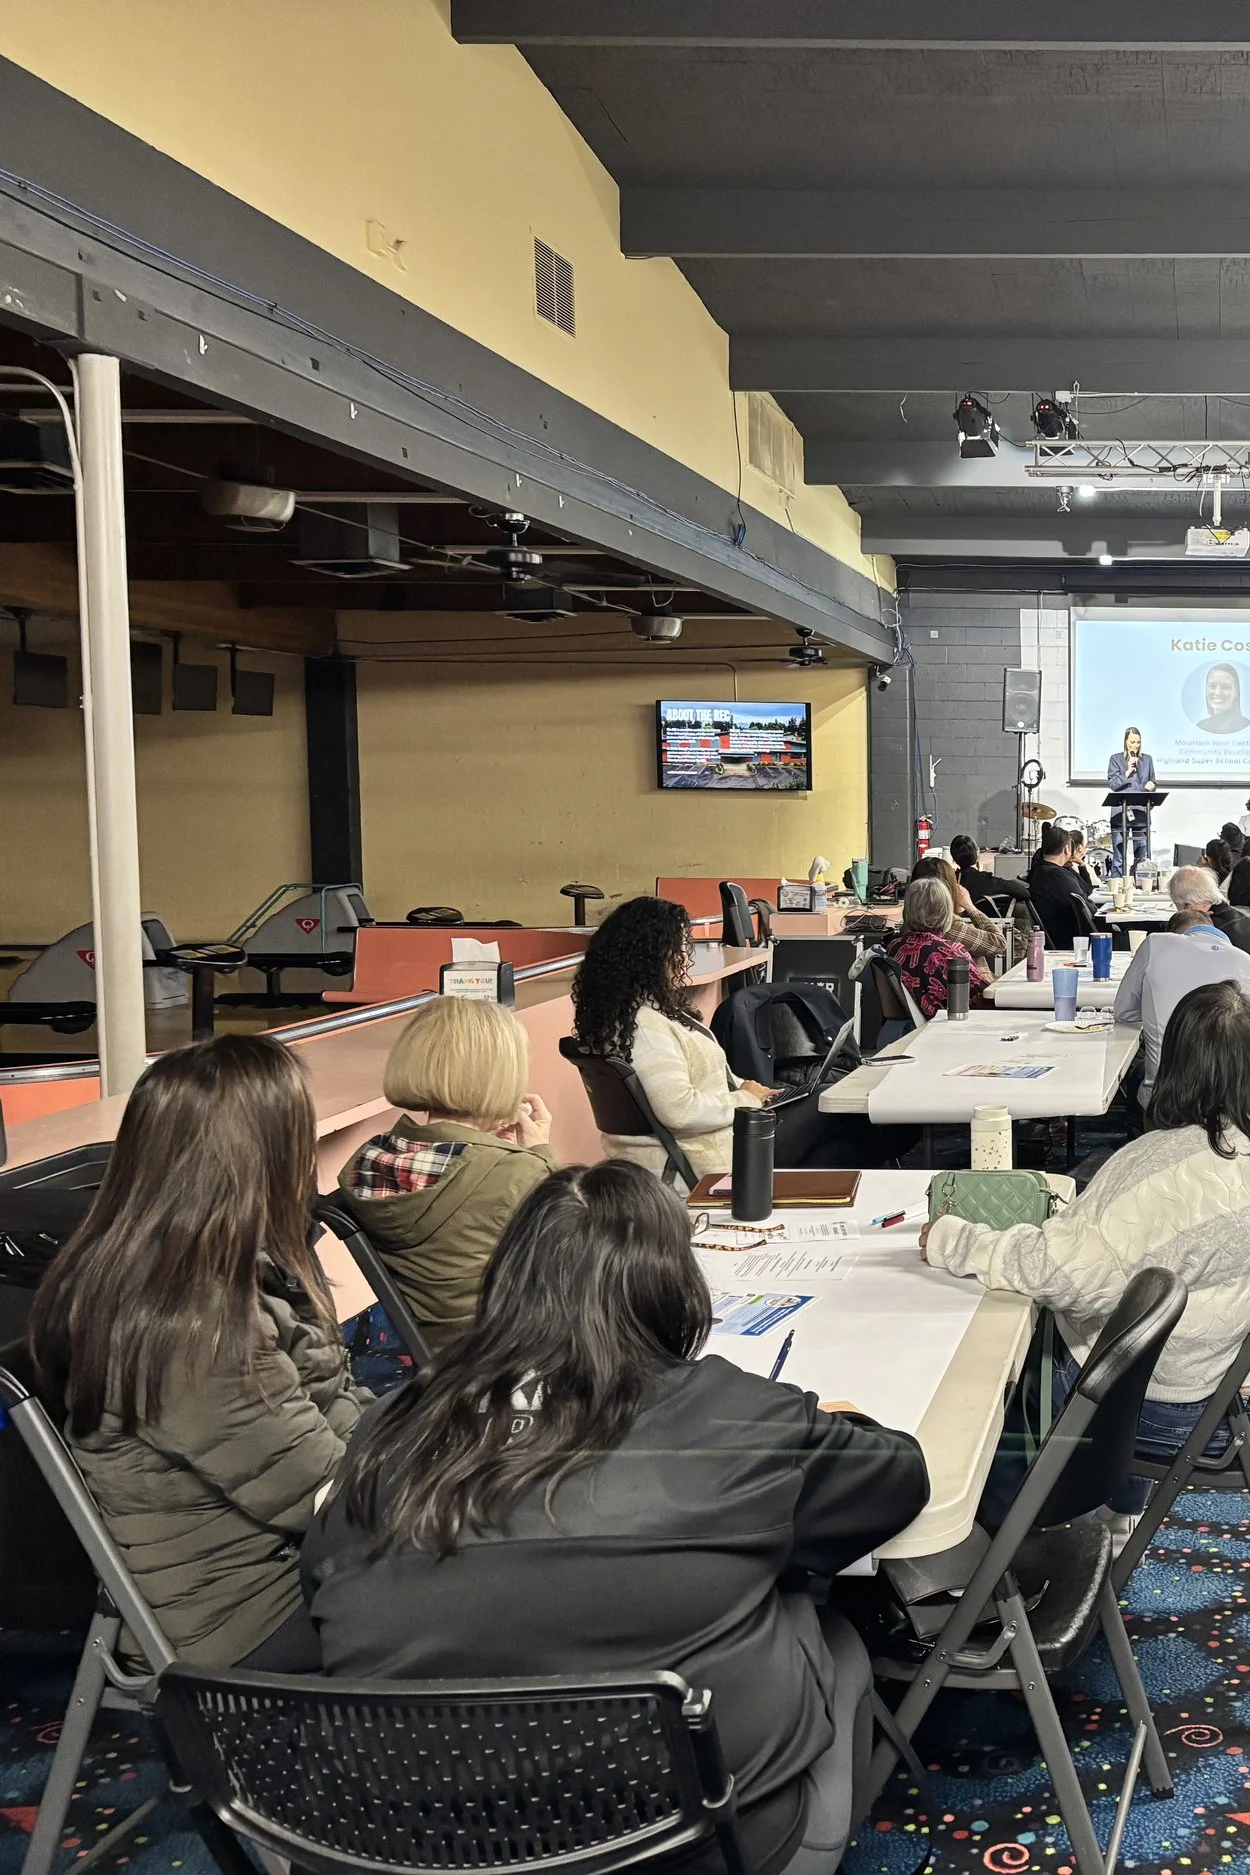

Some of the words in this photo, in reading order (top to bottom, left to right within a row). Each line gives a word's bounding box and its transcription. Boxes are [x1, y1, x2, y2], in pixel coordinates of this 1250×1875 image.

[1171, 638, 1217, 652] Katie
[666, 708, 694, 721] ABOUT
[695, 708, 712, 721] THE
[1174, 739, 1210, 747] Mountain
[1212, 739, 1230, 747] West
[1191, 757, 1213, 766] Super
[1215, 757, 1241, 765] School
